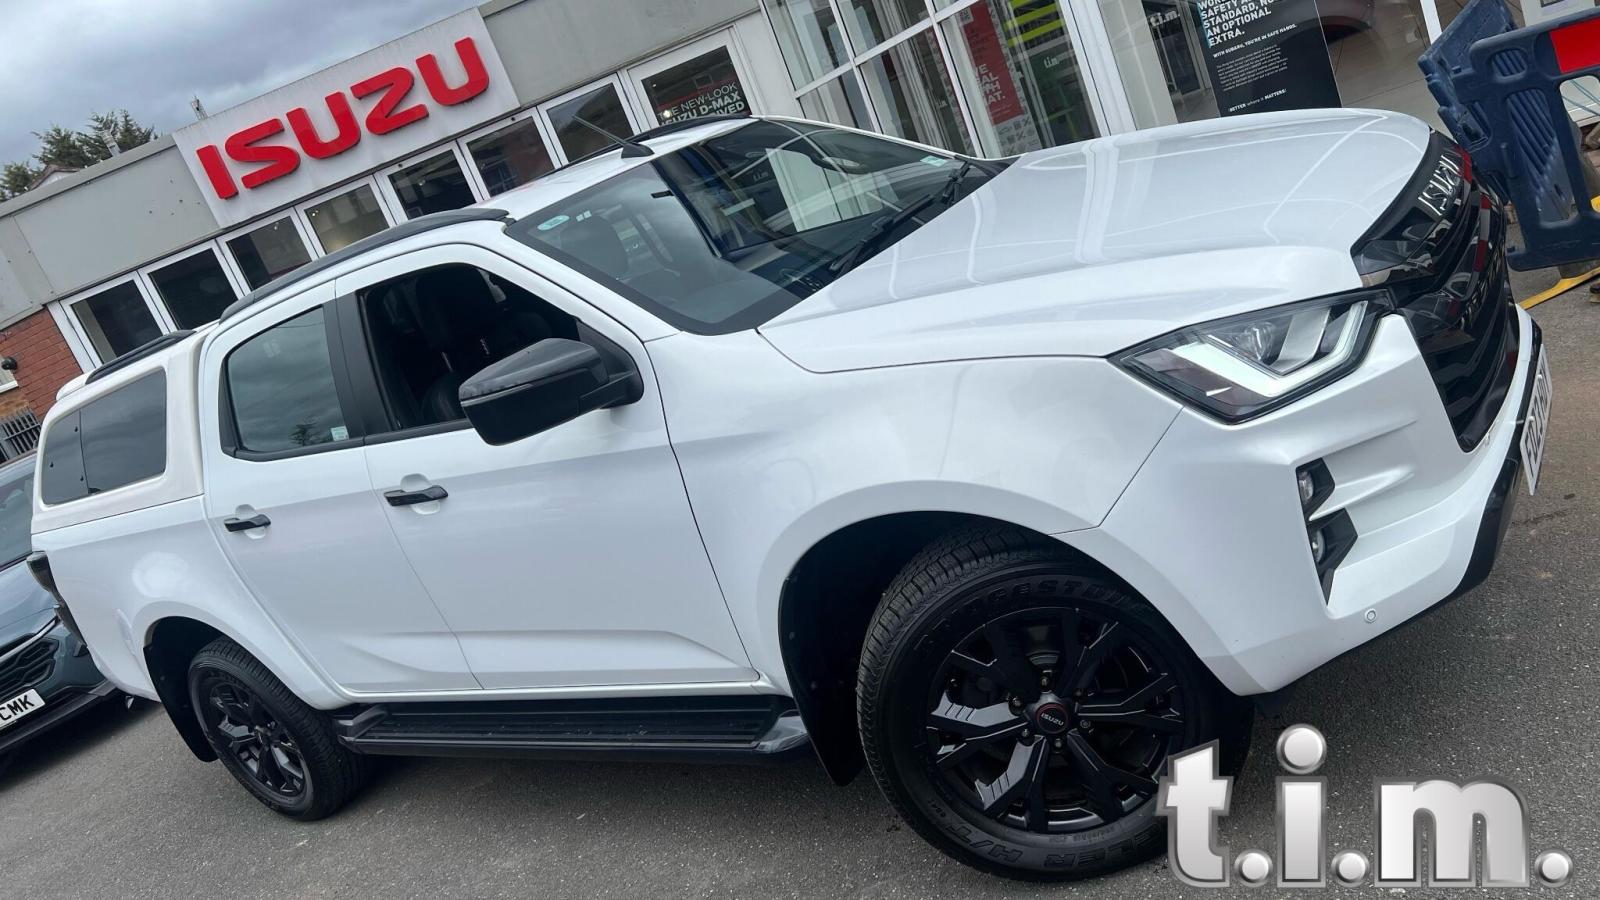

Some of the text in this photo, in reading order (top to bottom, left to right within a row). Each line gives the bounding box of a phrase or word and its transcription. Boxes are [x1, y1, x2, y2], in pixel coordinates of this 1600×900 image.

[1201, 0, 1238, 20] SAFETY
[1203, 2, 1259, 29] STANDARD,
[1207, 6, 1272, 38] AN OPTIONAL
[1209, 28, 1245, 47] EXTRA.
[658, 82, 738, 120] TE NEW-LOOK
[700, 91, 741, 115] D-MAX
[196, 37, 489, 199] ISUZU
[1418, 154, 1462, 216] ISUZU
[0, 694, 35, 721] CMK
